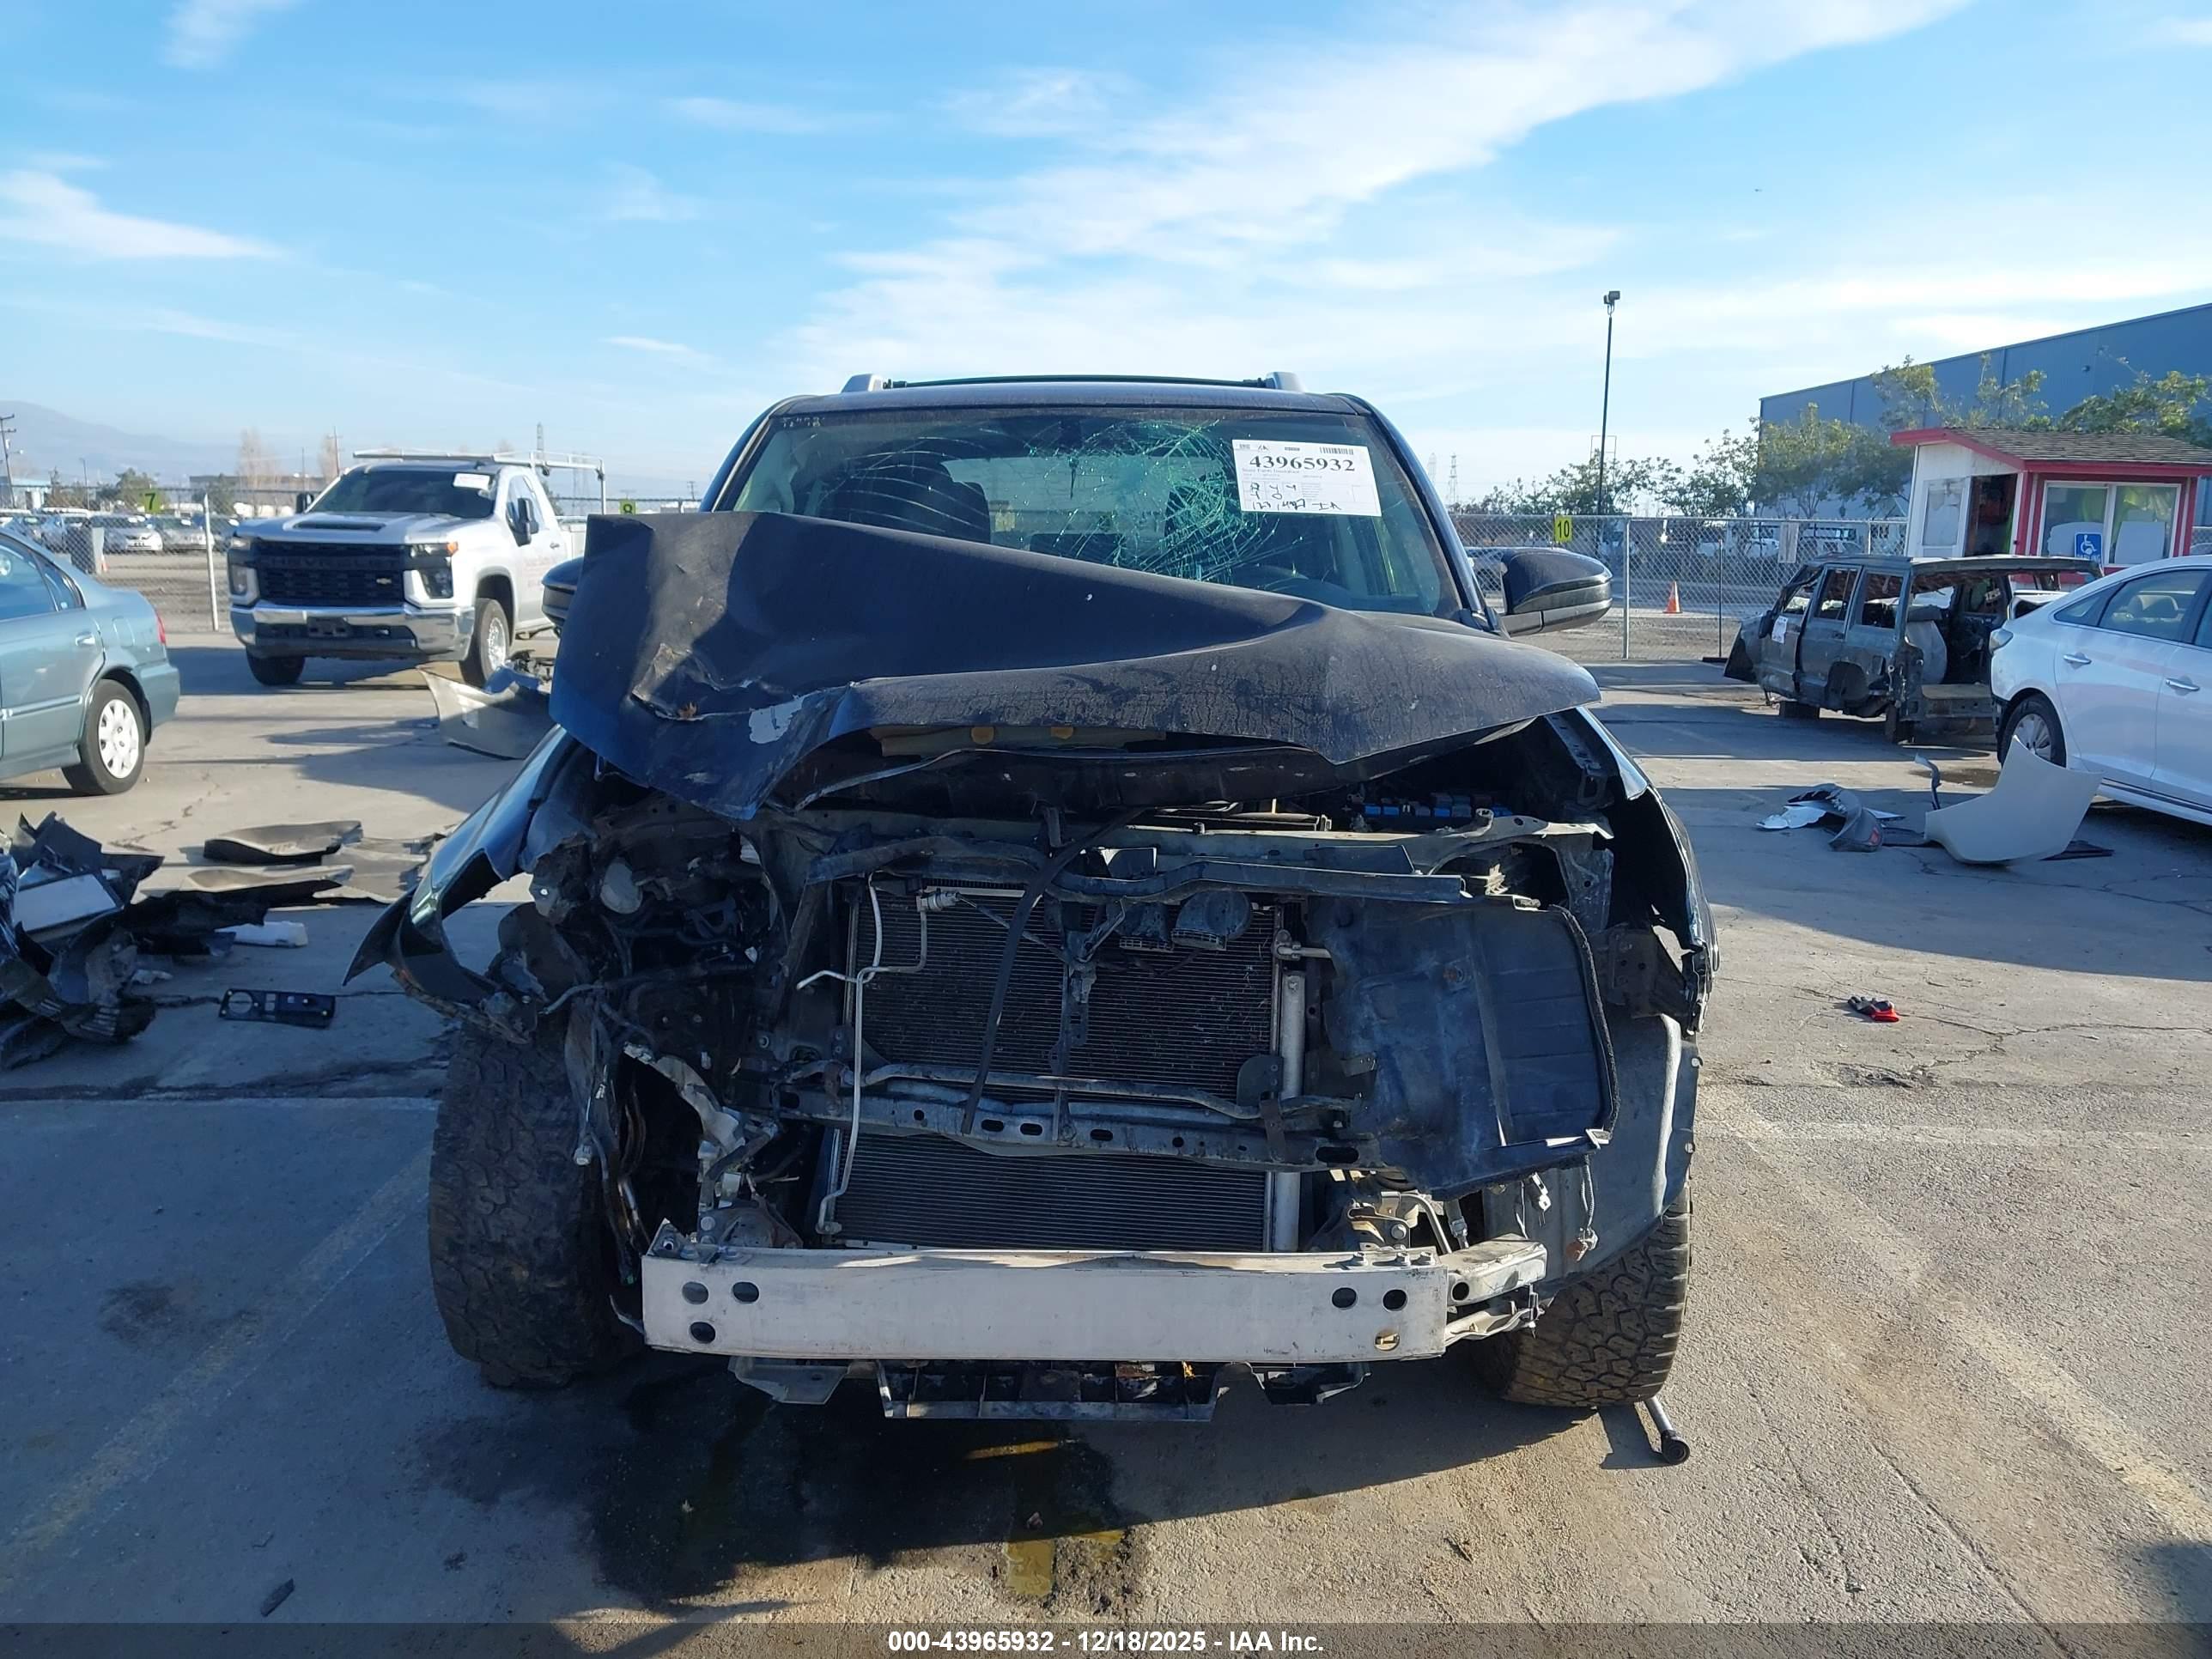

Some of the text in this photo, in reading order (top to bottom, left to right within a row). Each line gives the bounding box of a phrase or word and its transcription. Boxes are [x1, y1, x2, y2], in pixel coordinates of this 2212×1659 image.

[1249, 455, 1355, 471] 43965932
[144, 493, 155, 511] 7
[1557, 520, 1570, 538] 10
